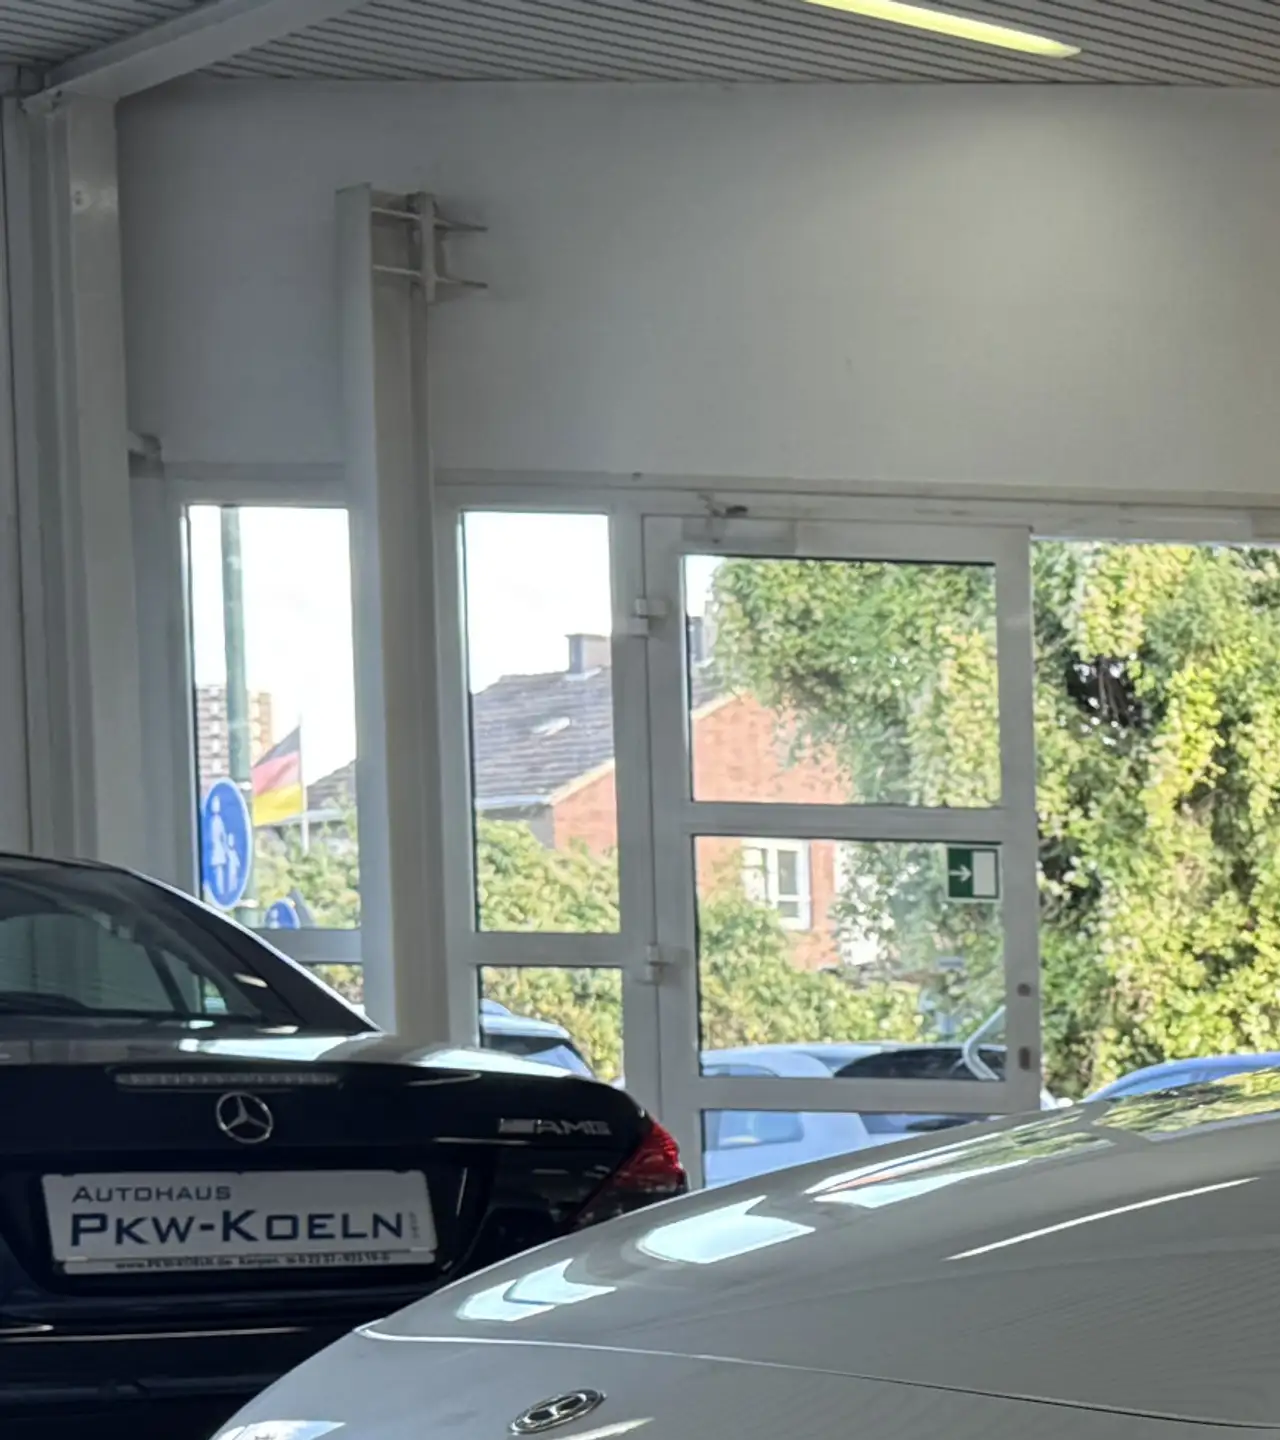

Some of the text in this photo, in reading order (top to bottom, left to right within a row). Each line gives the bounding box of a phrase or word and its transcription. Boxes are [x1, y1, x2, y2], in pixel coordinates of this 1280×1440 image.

[535, 1119, 613, 1136] AMG
[72, 1185, 232, 1203] AUTOHAUS
[70, 1209, 403, 1247] PKW-KOELN
